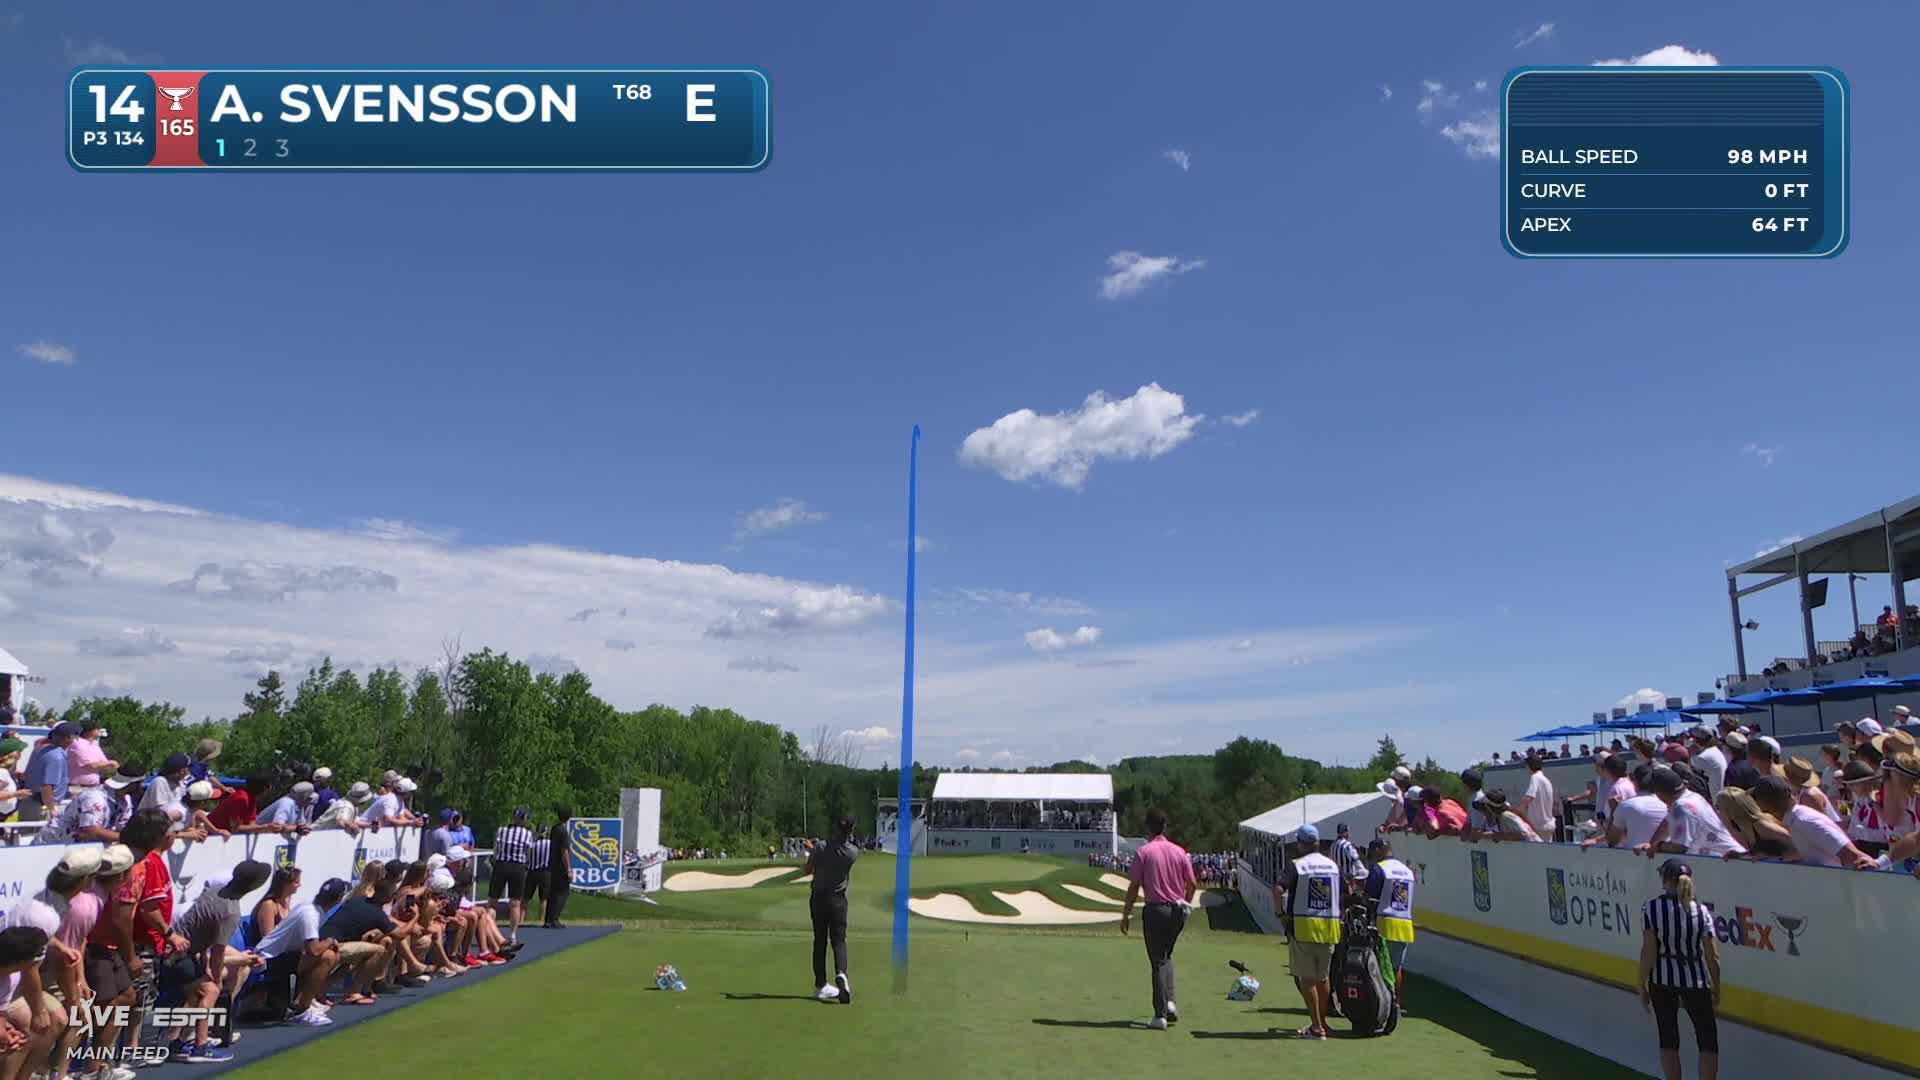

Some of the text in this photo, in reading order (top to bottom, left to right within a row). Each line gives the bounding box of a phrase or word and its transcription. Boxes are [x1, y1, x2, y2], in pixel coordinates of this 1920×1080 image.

[571, 867, 616, 884] RBC
[1568, 871, 1627, 896] CANADIAN
[1309, 899, 1330, 909] RBC
[1570, 895, 1631, 936] OPEN
